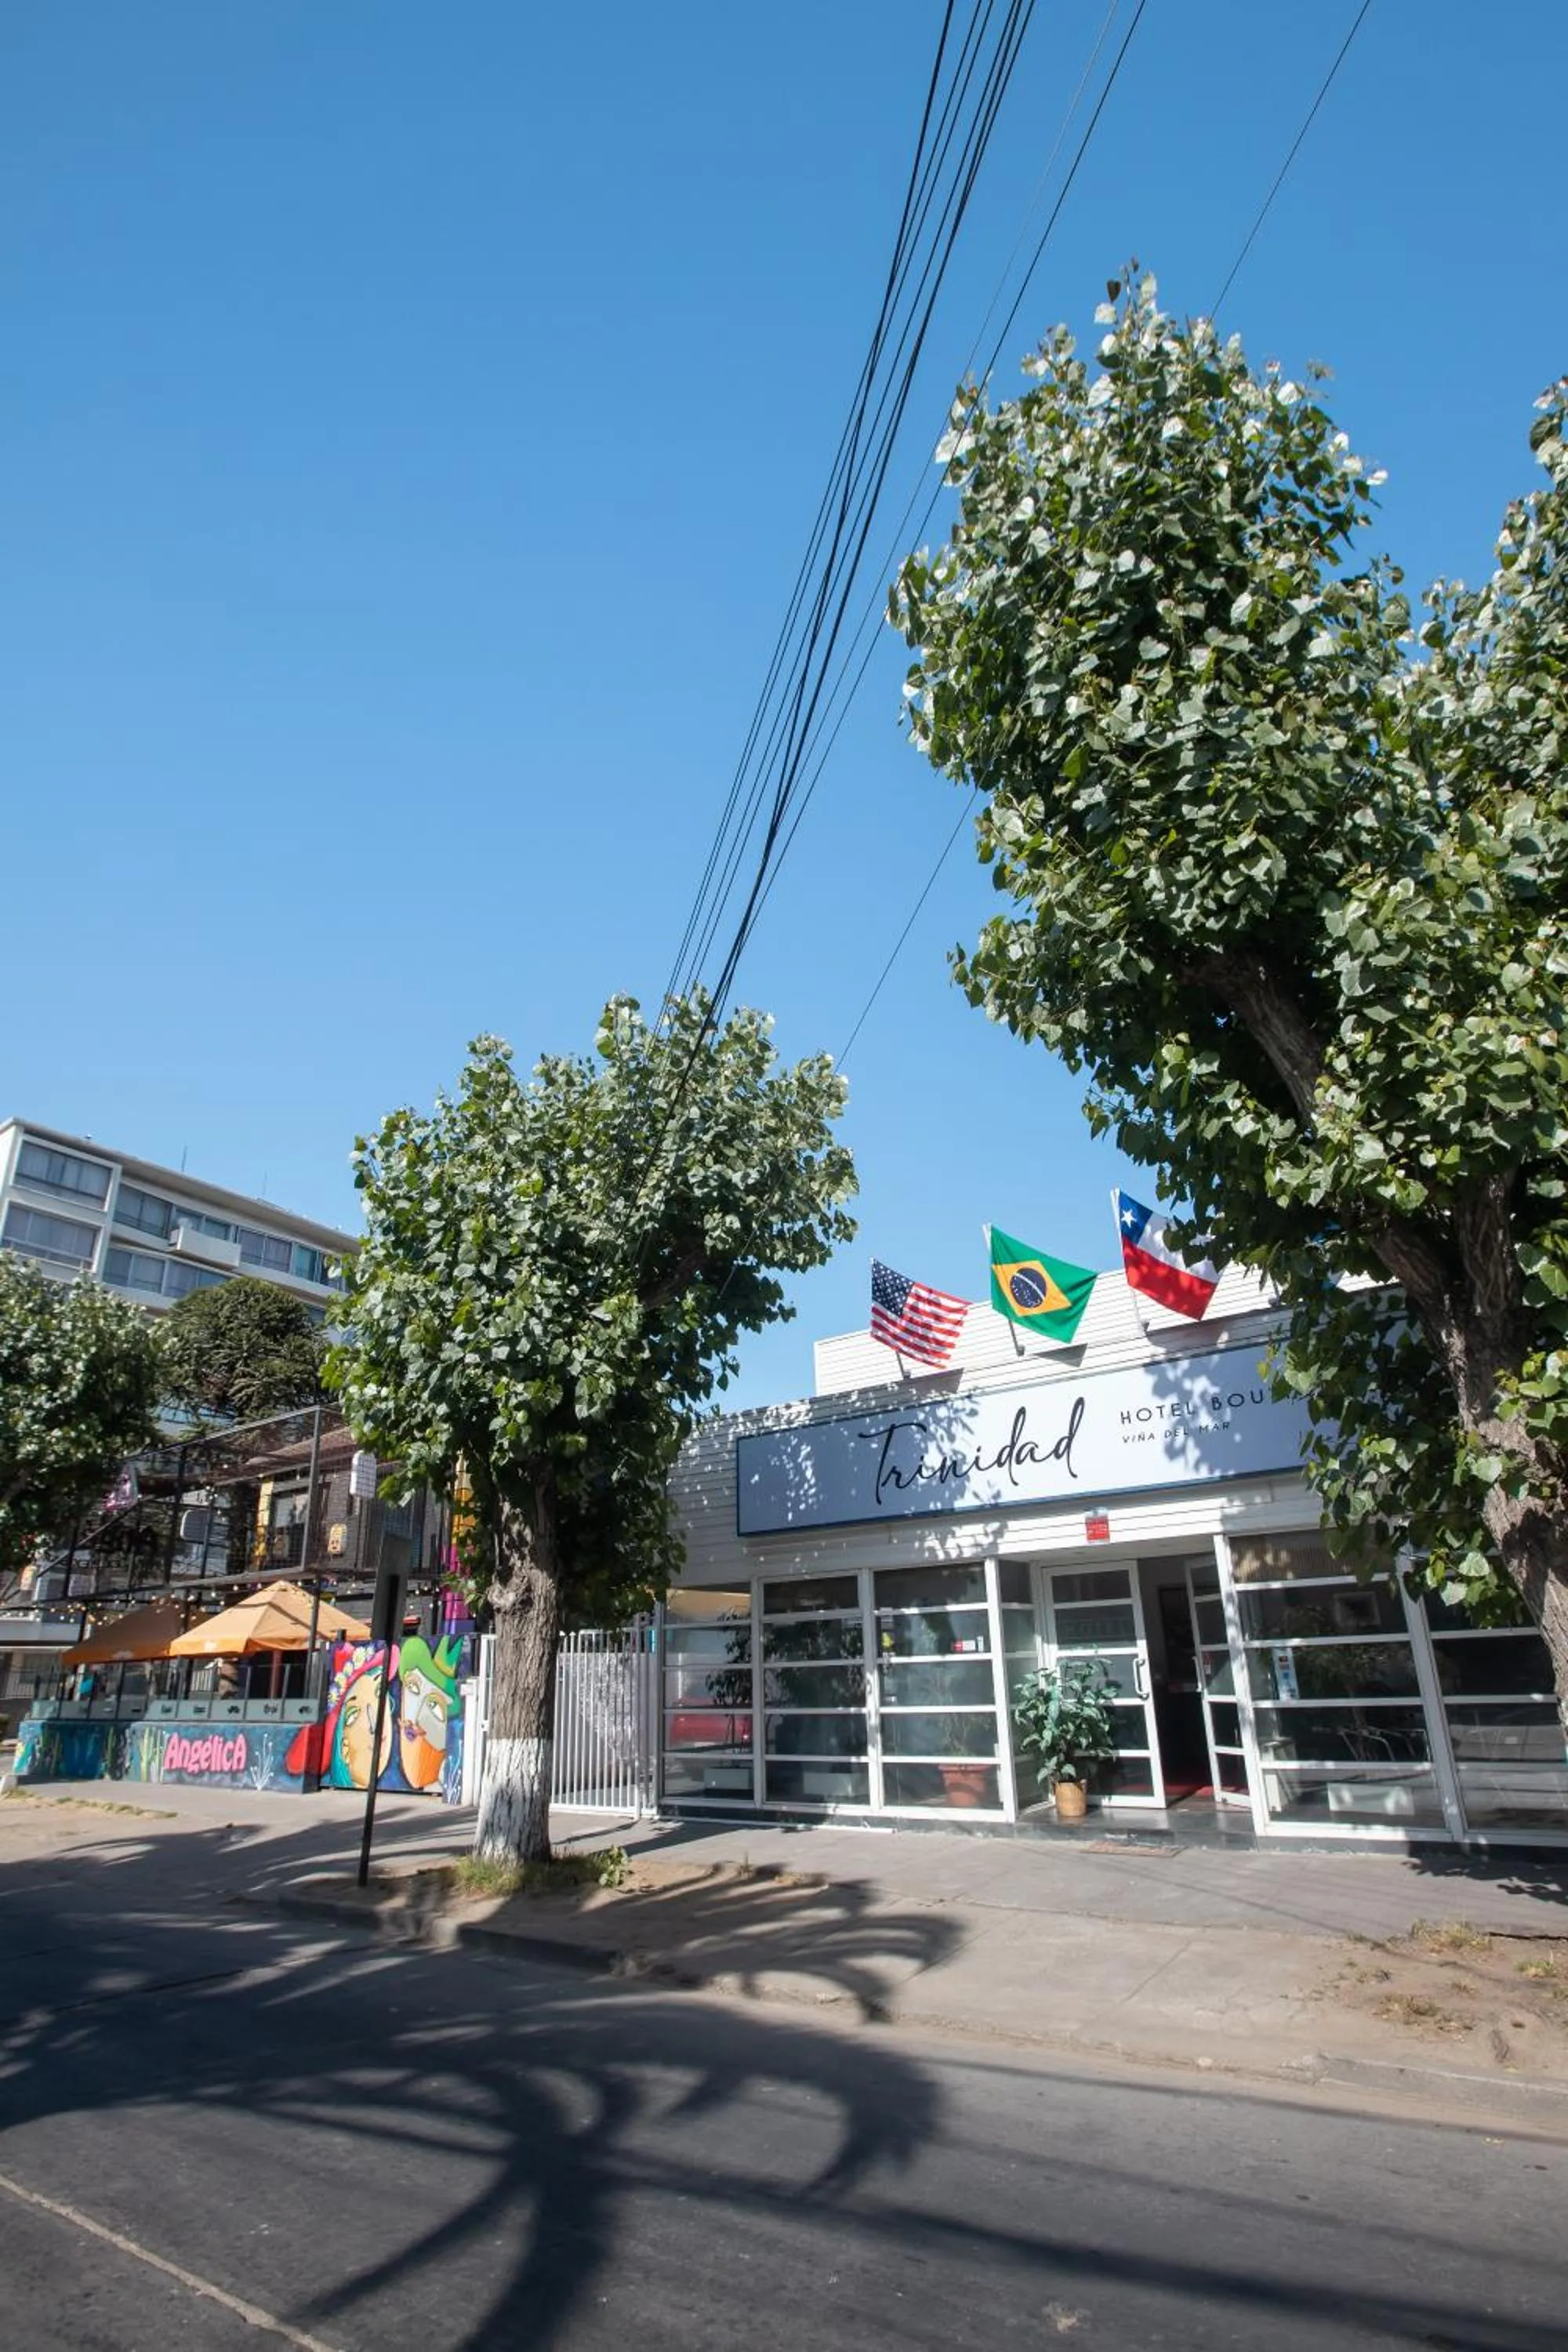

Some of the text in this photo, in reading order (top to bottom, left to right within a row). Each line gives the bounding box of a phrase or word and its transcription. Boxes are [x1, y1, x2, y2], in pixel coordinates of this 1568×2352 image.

[1120, 1388, 1270, 1425] HOTEL BOU
[1164, 1428, 1189, 1439] DEL
[1199, 1421, 1230, 1434] MAR
[858, 1396, 1085, 1505] Trinidad
